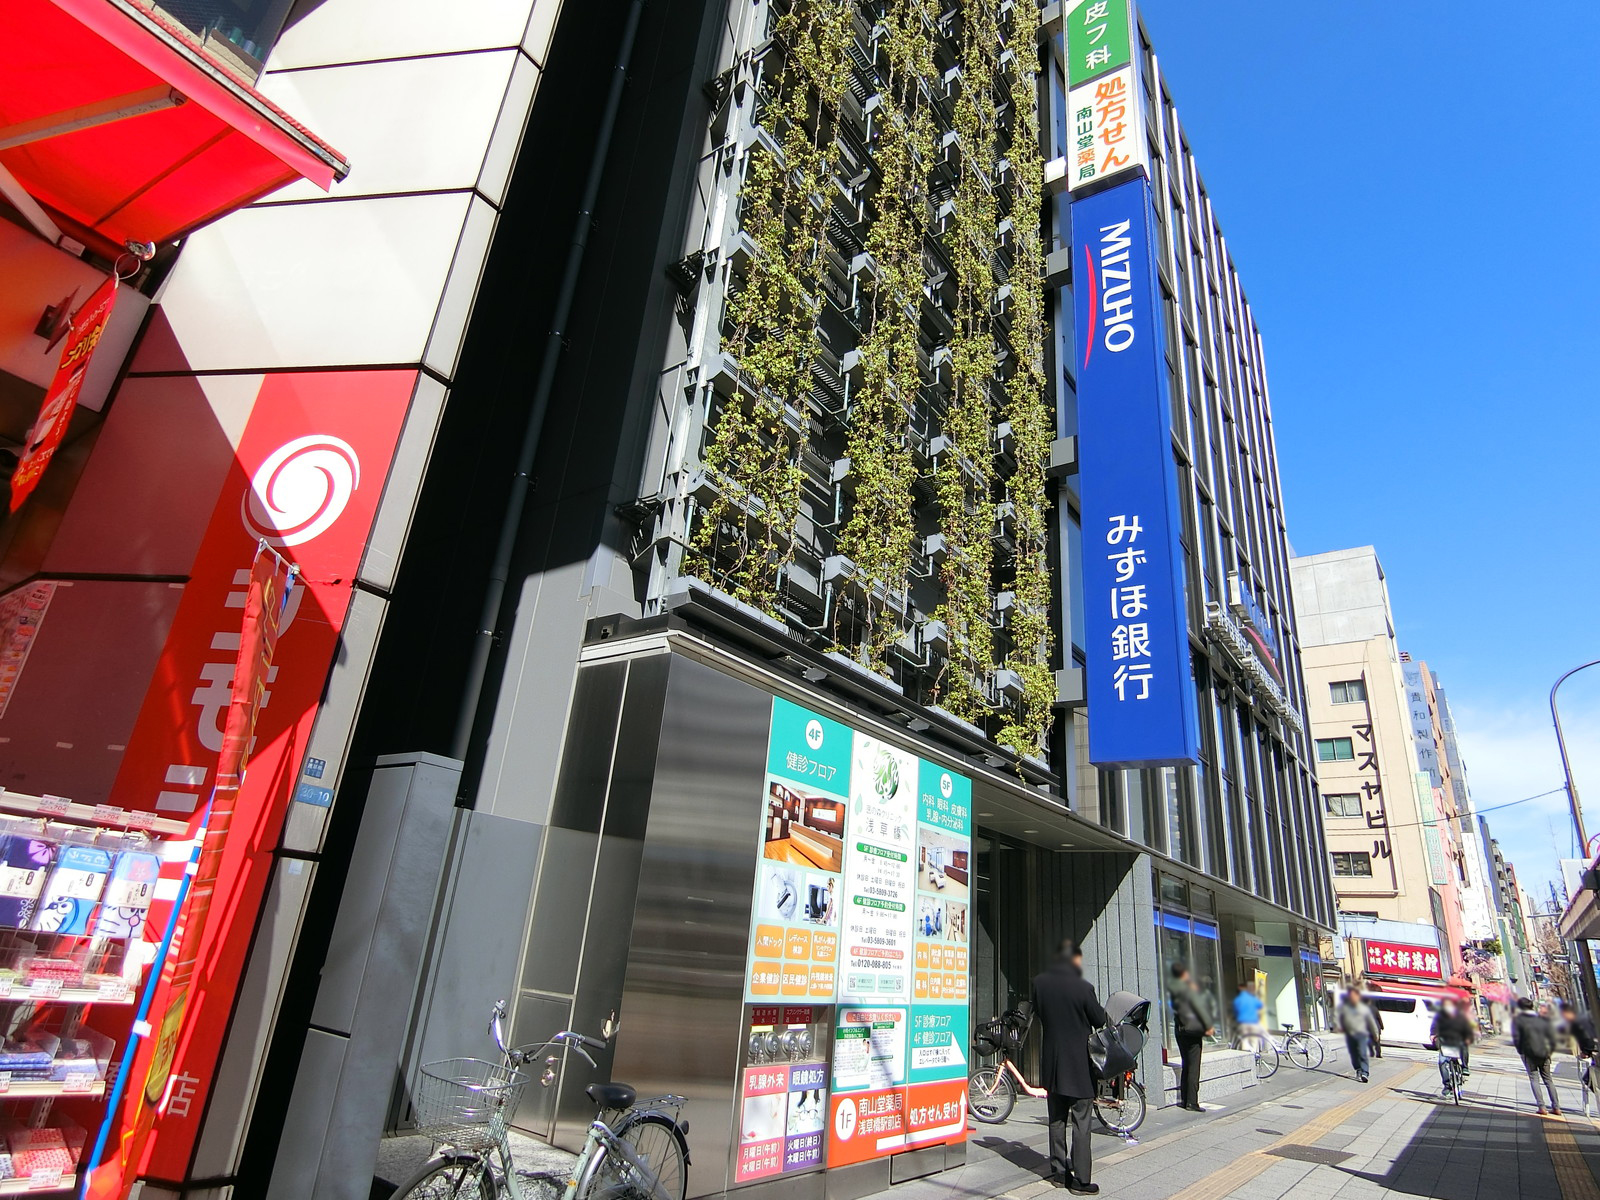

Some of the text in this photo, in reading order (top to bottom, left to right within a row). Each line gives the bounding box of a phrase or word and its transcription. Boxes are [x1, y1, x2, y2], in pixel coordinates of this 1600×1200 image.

[1084, 0, 1111, 70] 皮フ科
[1095, 77, 1129, 173] 処方せん
[1077, 105, 1096, 181] 南山堂薬局
[1099, 218, 1135, 353] MIZUHO
[1107, 514, 1153, 701] みずほ銀行
[808, 728, 821, 741] 4F
[786, 751, 837, 781] 健診フロア
[942, 779, 951, 790] 5F
[1352, 723, 1391, 859] マスヤビル
[922, 793, 934, 808] 内科
[757, 936, 782, 947] 人間ドック
[1383, 948, 1438, 972] 水新菜館
[752, 972, 780, 985] 企業健診
[783, 974, 808, 986] 区民健診
[923, 1014, 952, 1028] 診療フロア
[922, 1030, 951, 1045] 健診フロア
[749, 1072, 784, 1090] 乳腺外来
[792, 1069, 825, 1086] 眼鏡処方
[858, 1093, 902, 1117] 南山堂薬局
[909, 1101, 958, 1126] 処方せん受付
[840, 1109, 852, 1130] 1F
[858, 1114, 902, 1136] 浅草橋駅前店
[743, 1142, 780, 1160] 月曜日(午前)
[788, 1135, 821, 1151] 火曜日(終日)
[742, 1156, 778, 1174] 水曜日(午前)
[787, 1148, 820, 1165] 木曜日(午前)
